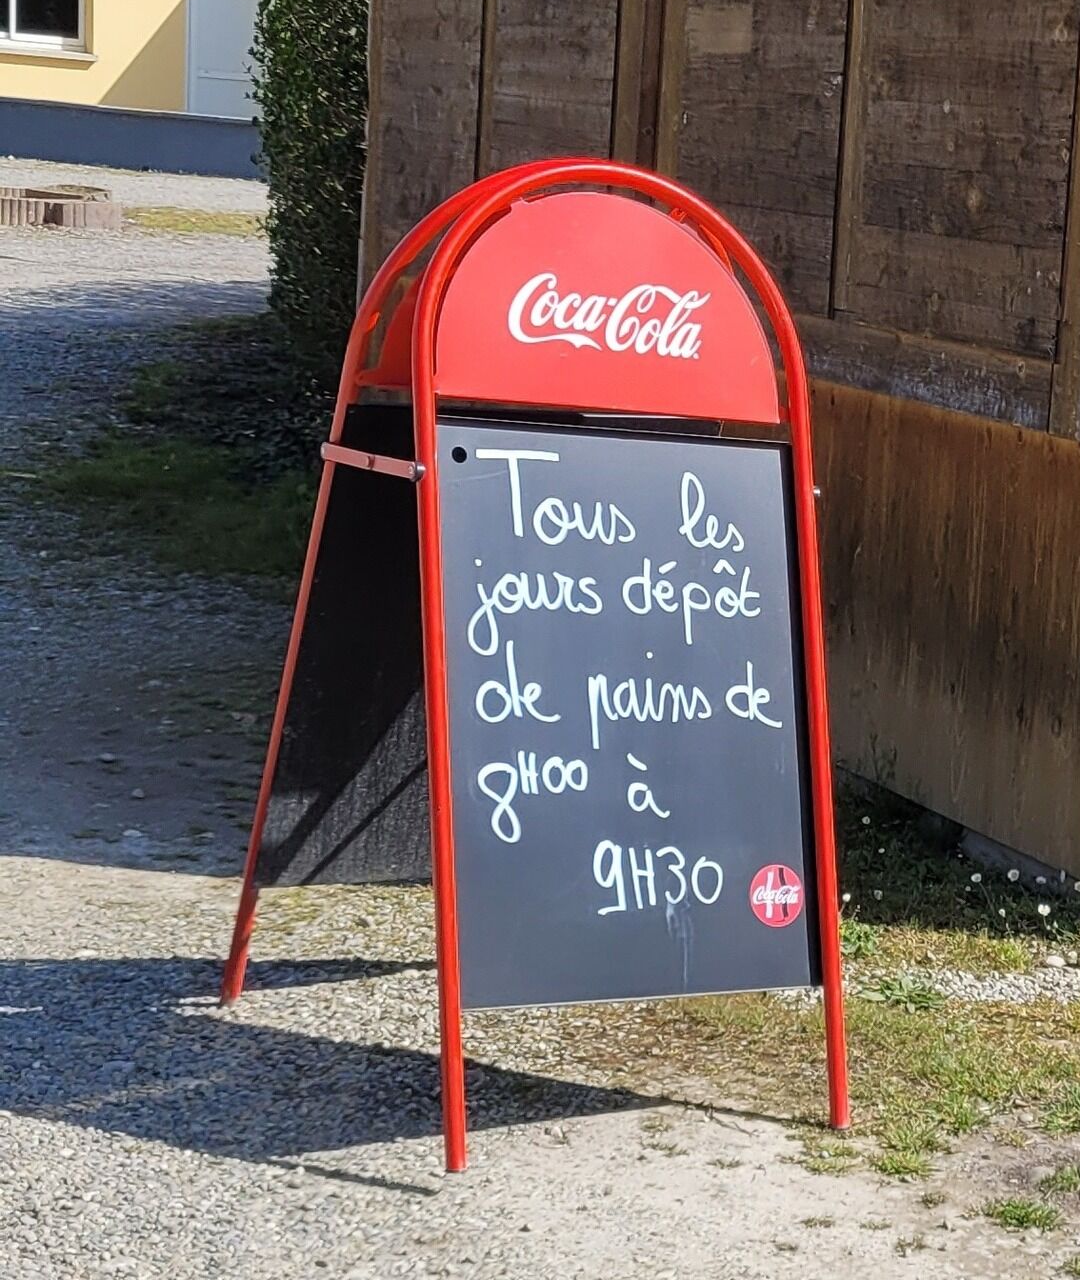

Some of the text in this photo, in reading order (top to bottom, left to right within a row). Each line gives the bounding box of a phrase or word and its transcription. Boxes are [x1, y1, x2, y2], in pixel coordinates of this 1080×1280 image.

[507, 272, 711, 359] Coca-Cola
[475, 448, 745, 552] Tous les
[467, 557, 761, 656] jours dépôt
[475, 640, 783, 750] de pains de
[477, 750, 670, 843] 8H00 à
[593, 839, 723, 915] 9H30
